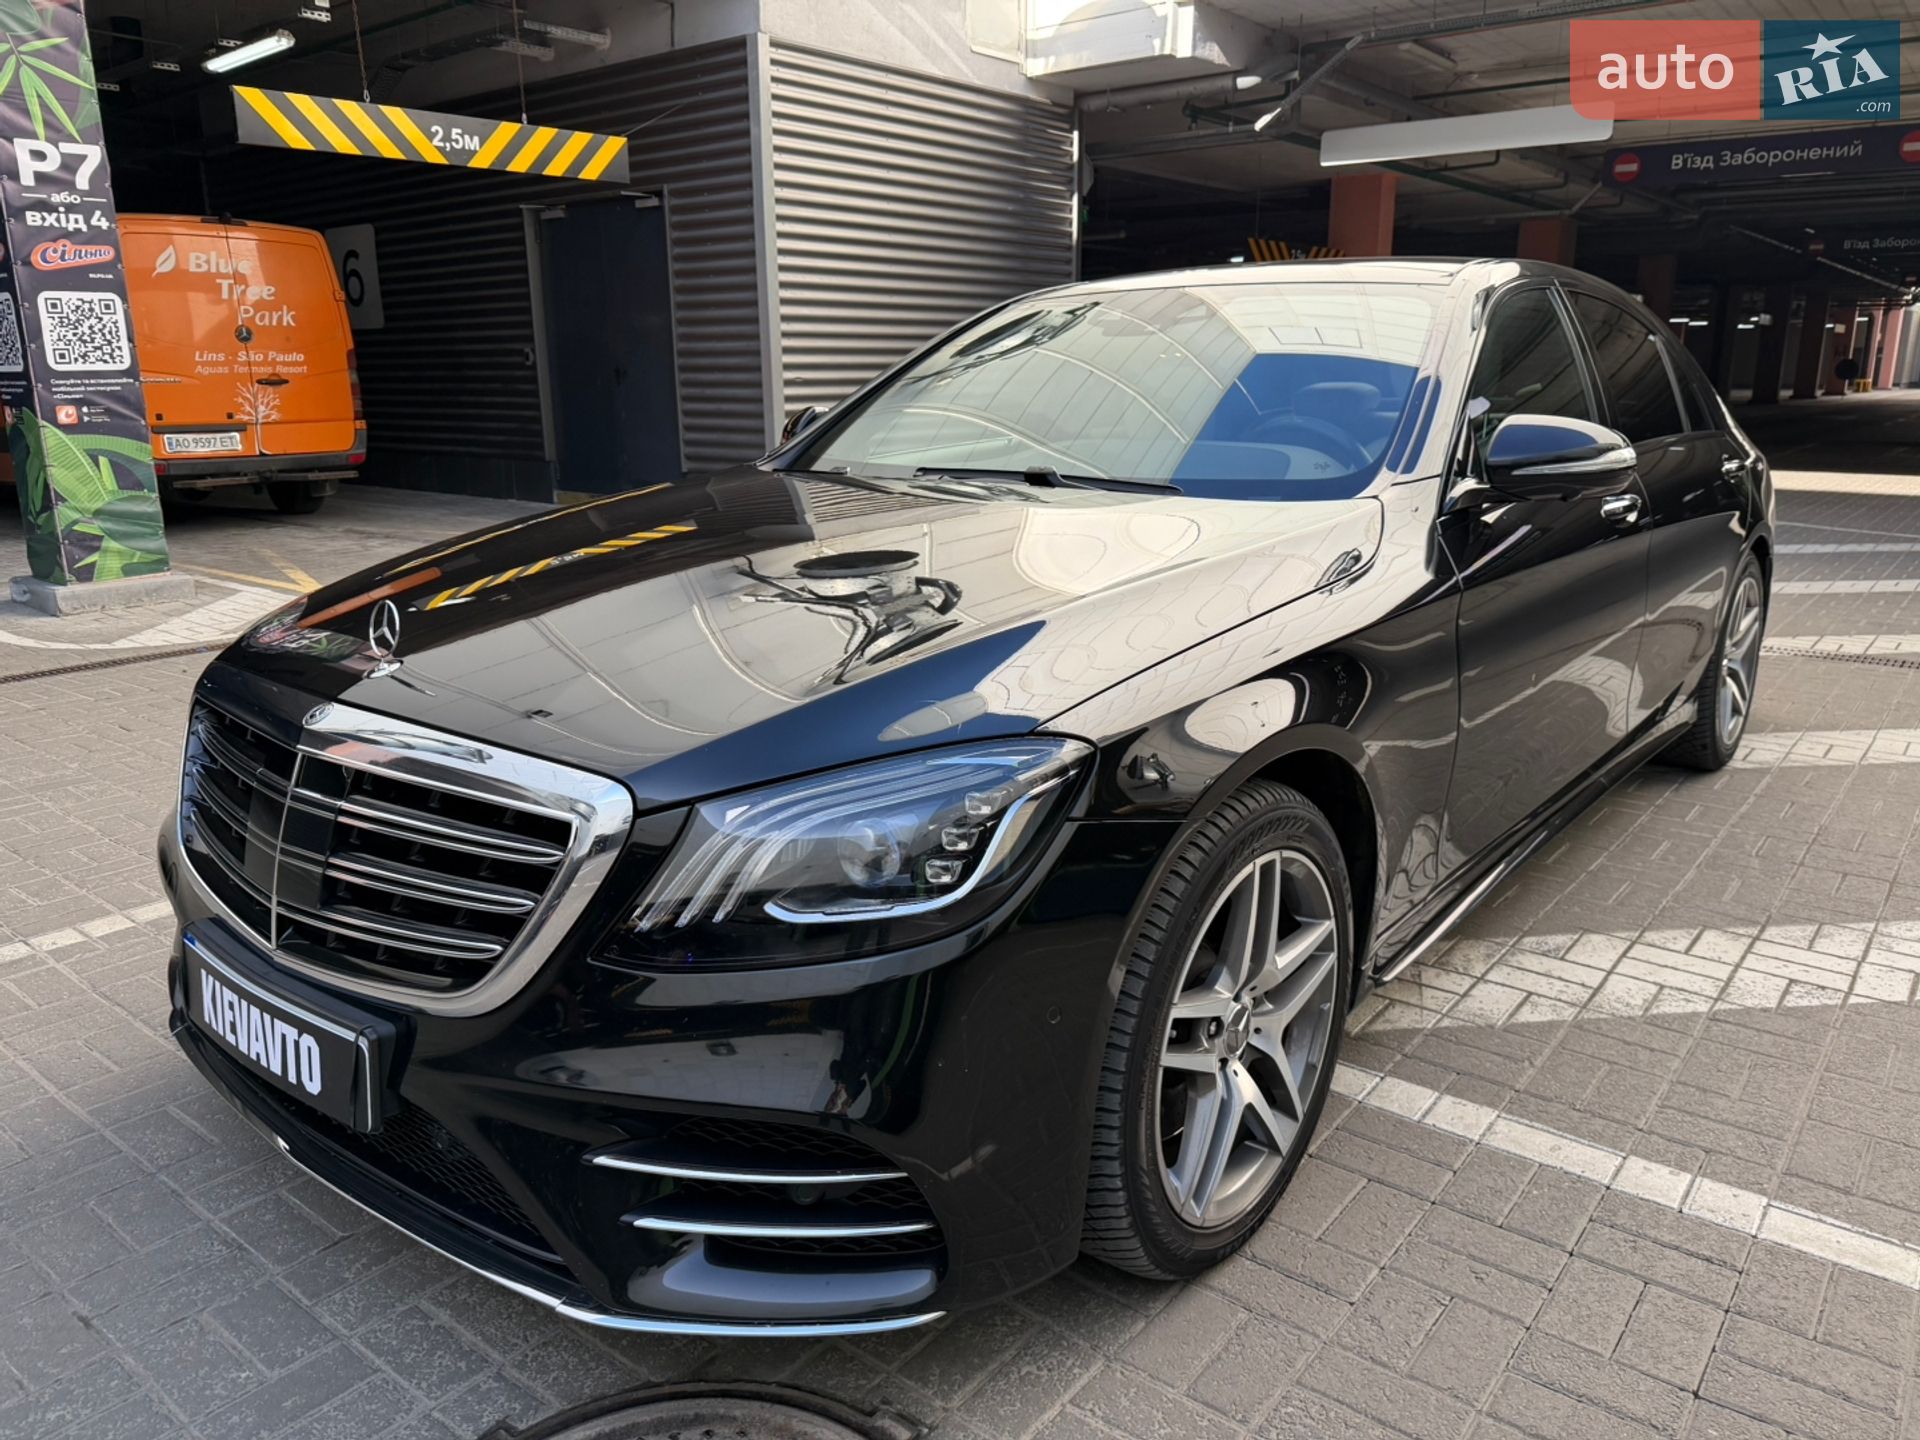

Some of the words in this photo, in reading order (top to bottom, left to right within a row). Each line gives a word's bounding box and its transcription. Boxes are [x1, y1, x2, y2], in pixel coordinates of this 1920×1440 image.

[14, 138, 101, 190] P7
[1720, 139, 1864, 167] Заборонений
[51, 191, 81, 203] або
[26, 206, 88, 232] вхід
[90, 210, 110, 230] 4
[189, 252, 255, 274] Blue
[342, 249, 365, 306] 6
[216, 279, 276, 300] Tree
[239, 305, 296, 327] Park
[194, 350, 226, 361] Lins
[268, 351, 305, 361] Paulo
[276, 365, 308, 373] Resort
[191, 437, 217, 449] 9597
[219, 436, 235, 447] ET
[201, 968, 322, 1096] KIEVAVTO
